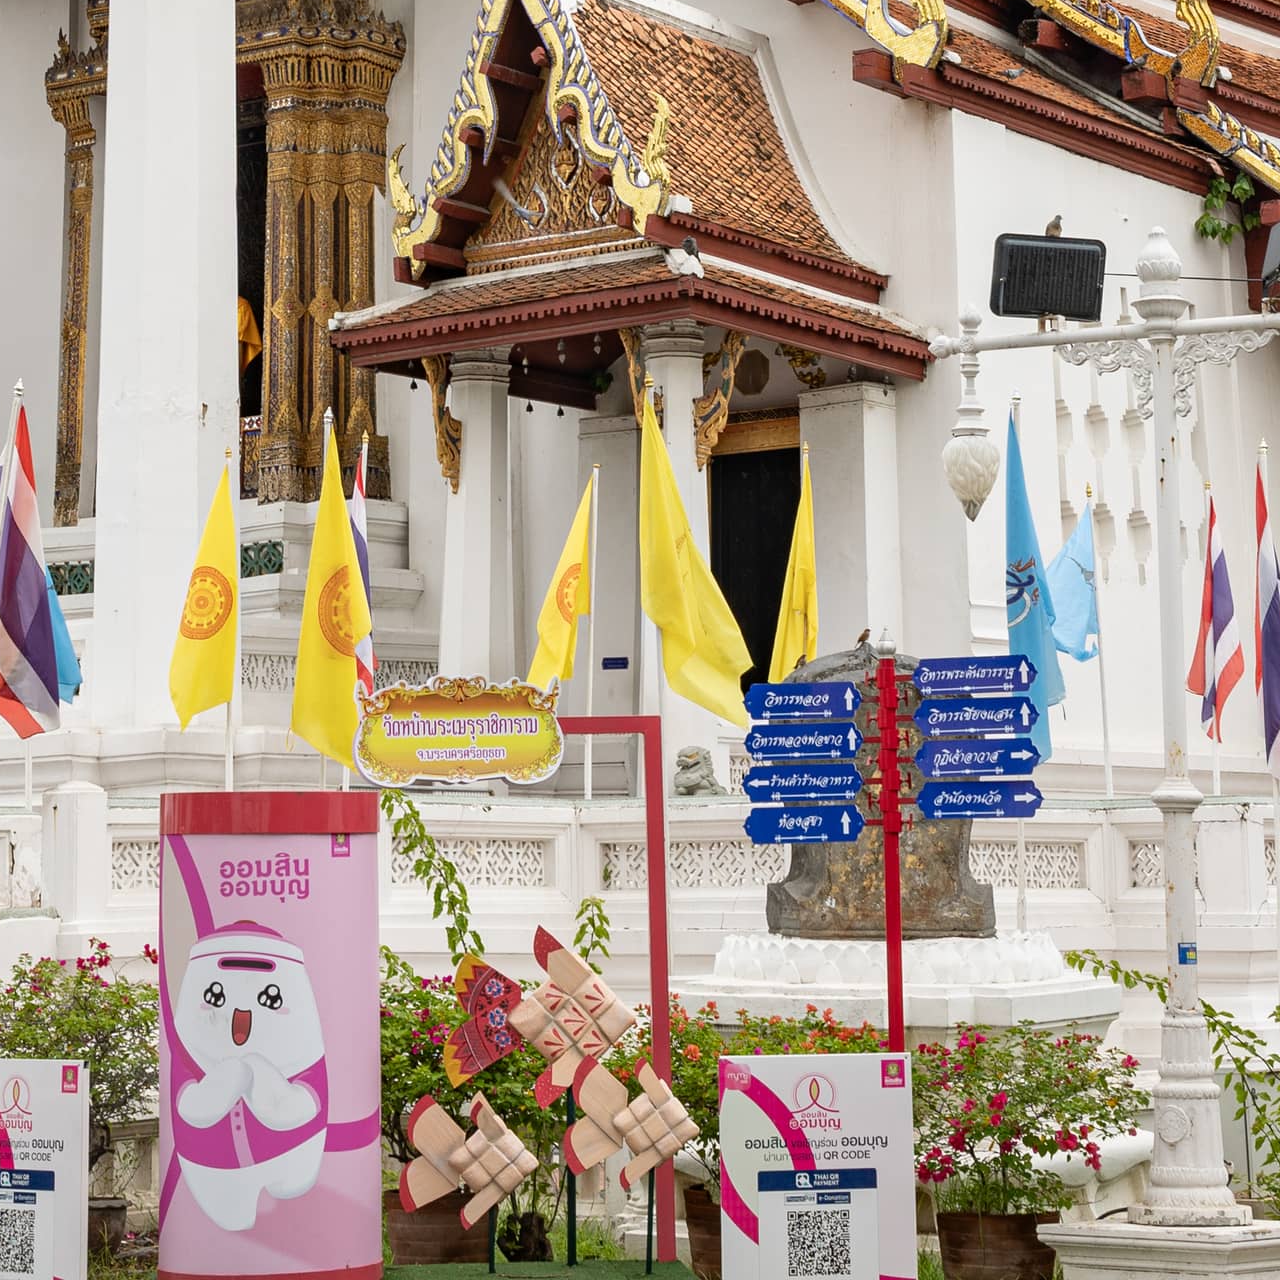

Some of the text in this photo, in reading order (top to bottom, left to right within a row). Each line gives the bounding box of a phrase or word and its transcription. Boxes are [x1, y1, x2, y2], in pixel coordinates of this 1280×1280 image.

[764, 692, 830, 708] วิหารหลวง
[928, 706, 1016, 724] วิหารเชียงแสน
[383, 713, 538, 740] วัดหน้าพระเมรุราชิการาม
[752, 731, 843, 749] วิหารหลวงพ่อขาว
[417, 747, 506, 763] จ.พระนครศรีอยุธยา
[770, 773, 854, 788] ร้านค้าร้านอาหาร
[934, 789, 1002, 806] สำนักงานวัด
[778, 814, 823, 833] ห้องสุขา
[220, 852, 310, 878] ออมสิน
[220, 879, 310, 903] ออมบุญ
[790, 1118, 841, 1132] ออมบุญ
[31, 1138, 64, 1153] ออมบุญ
[745, 1136, 787, 1149] ออมสิน
[841, 1136, 888, 1150] ออมบุญ
[823, 1150, 839, 1161] QR
[841, 1150, 871, 1160] CODE
